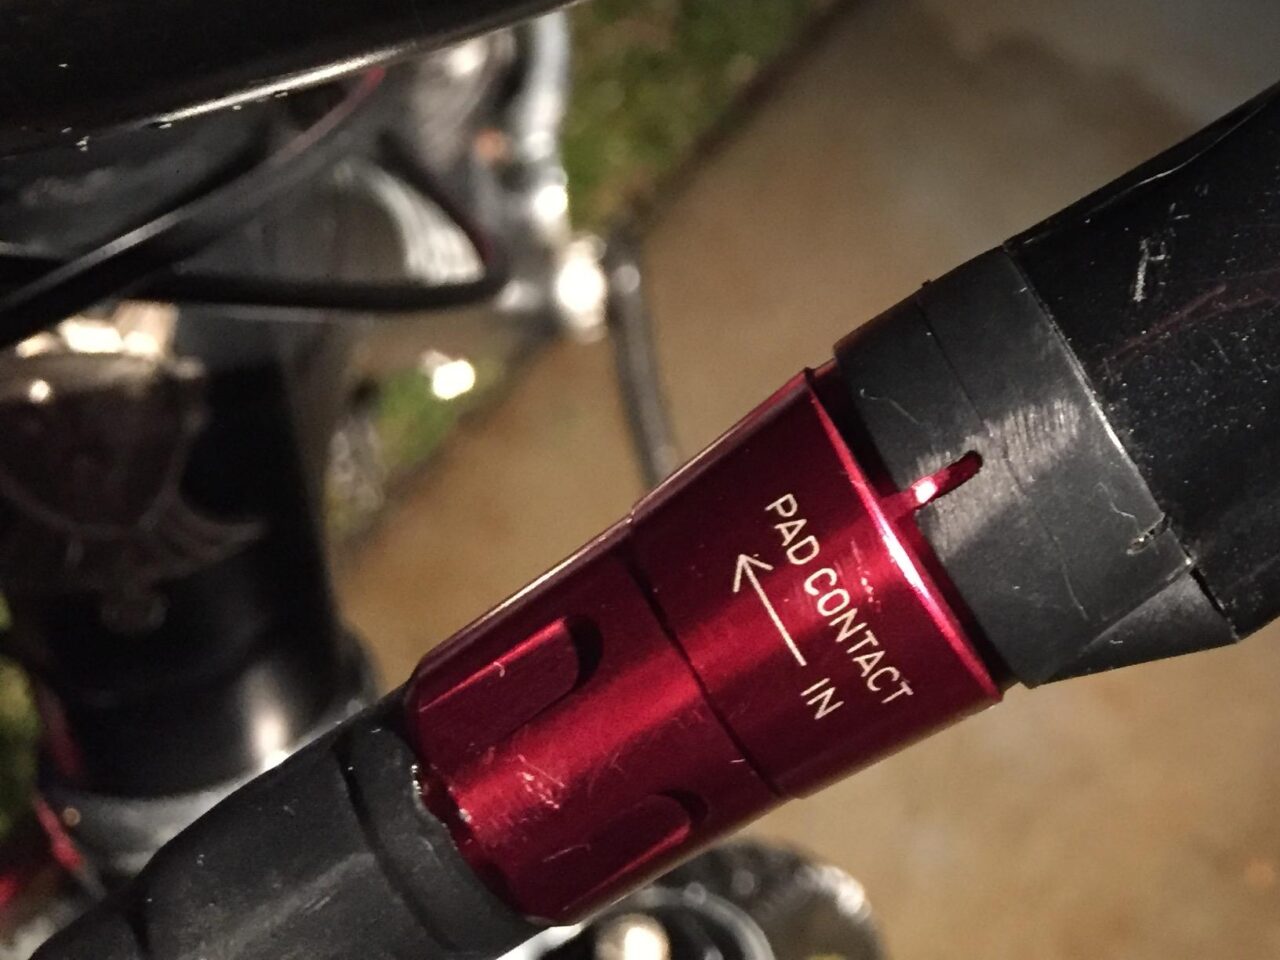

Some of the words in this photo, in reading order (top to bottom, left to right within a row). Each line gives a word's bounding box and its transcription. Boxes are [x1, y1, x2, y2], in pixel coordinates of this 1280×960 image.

[764, 493, 821, 566] PAD
[803, 567, 914, 705] CONTACT
[800, 677, 845, 721] IN
